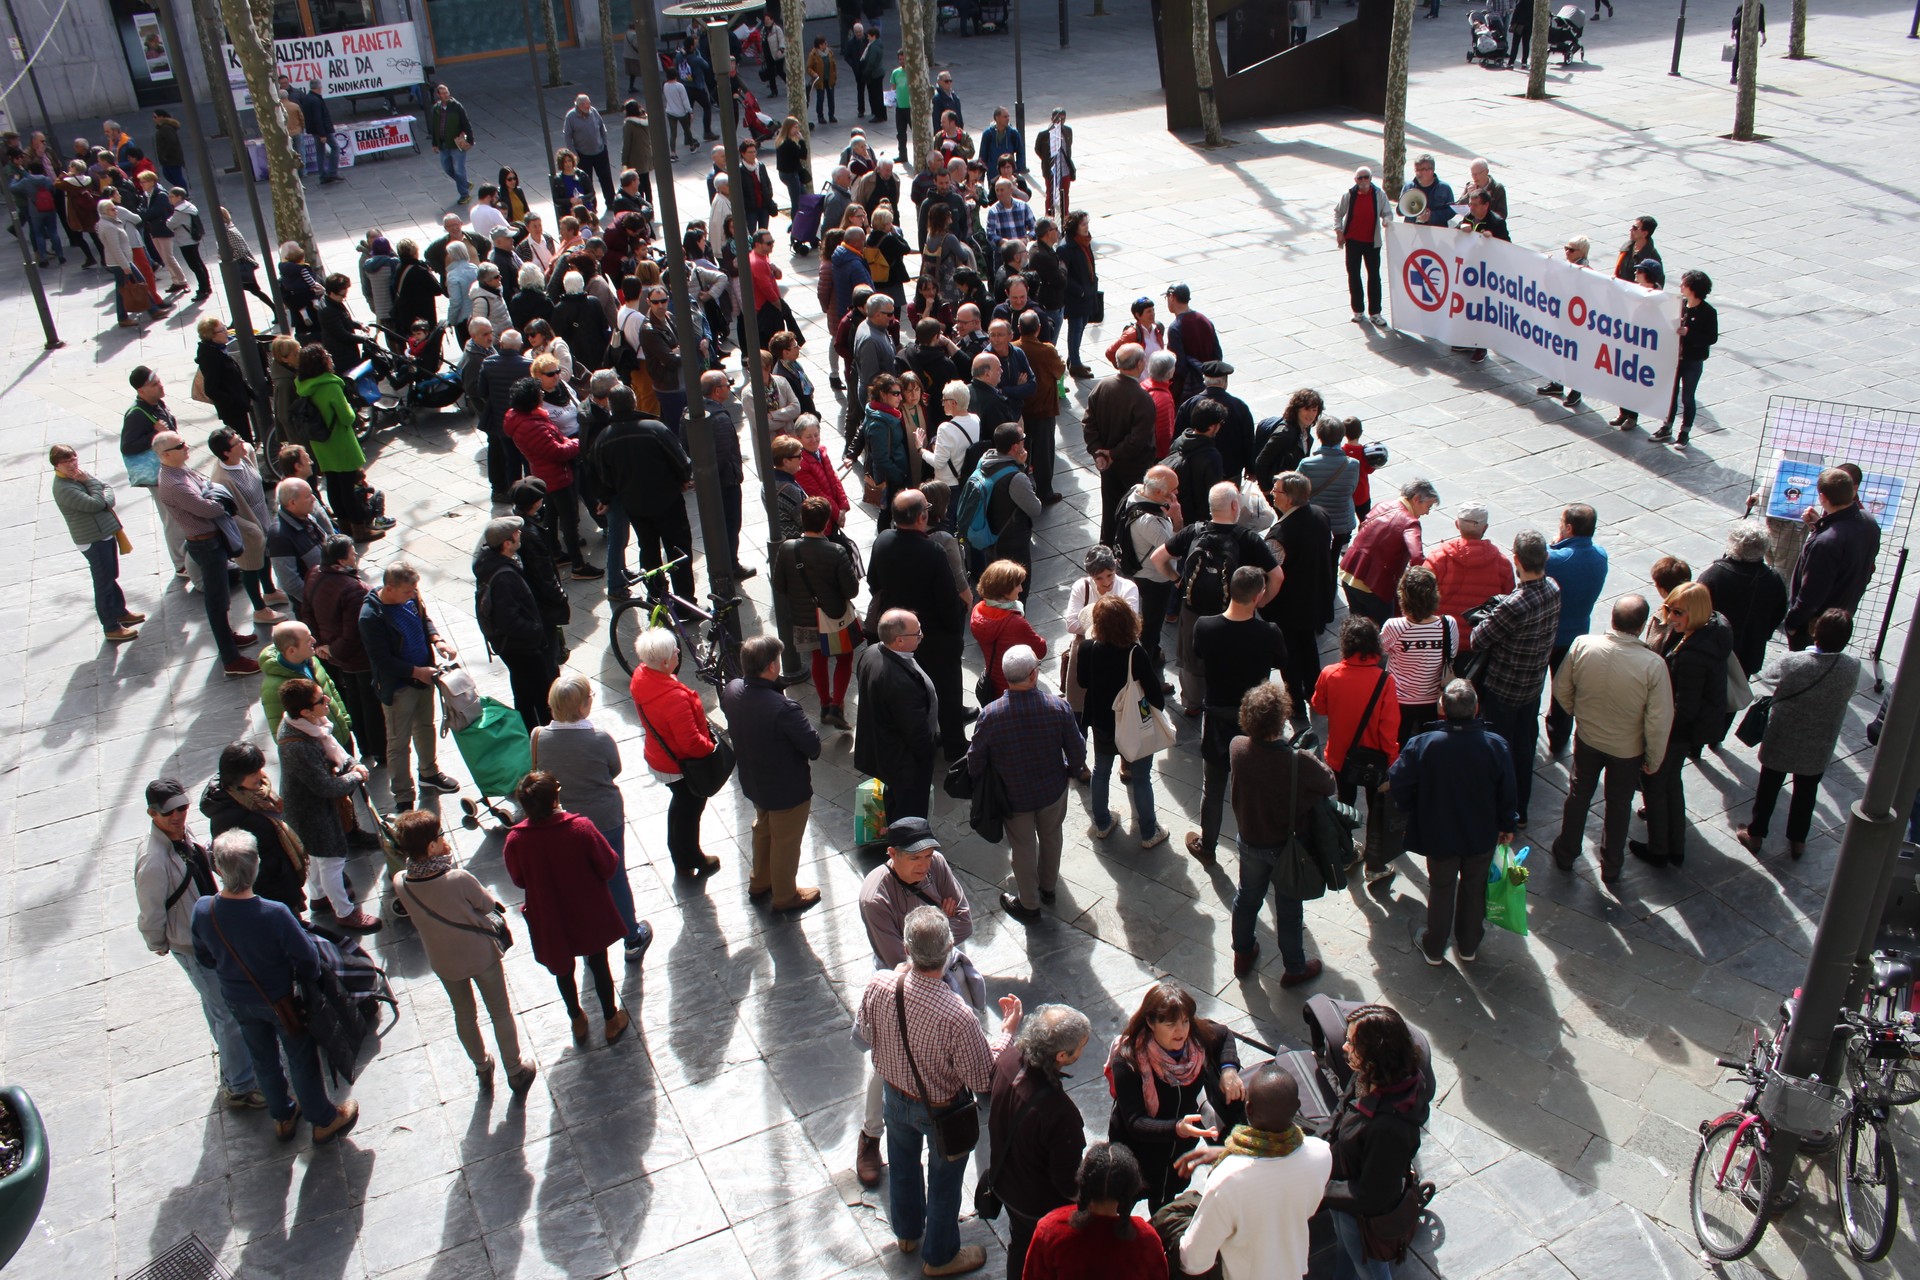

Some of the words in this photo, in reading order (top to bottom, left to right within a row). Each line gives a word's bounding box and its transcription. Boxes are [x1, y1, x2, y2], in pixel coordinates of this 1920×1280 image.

[228, 39, 335, 69] KALISMOA
[342, 29, 403, 55] PLANETA
[328, 59, 349, 79] ARI
[355, 55, 374, 75] DA
[328, 76, 383, 94] SINDIKATUA
[355, 127, 385, 141] EZKER
[357, 133, 410, 152] IRAULTZAILEA
[1454, 256, 1561, 319] Tolosaldea
[1568, 296, 1658, 351] Osasun
[1449, 291, 1578, 361] Publikoaren
[1594, 343, 1656, 387] Alde
